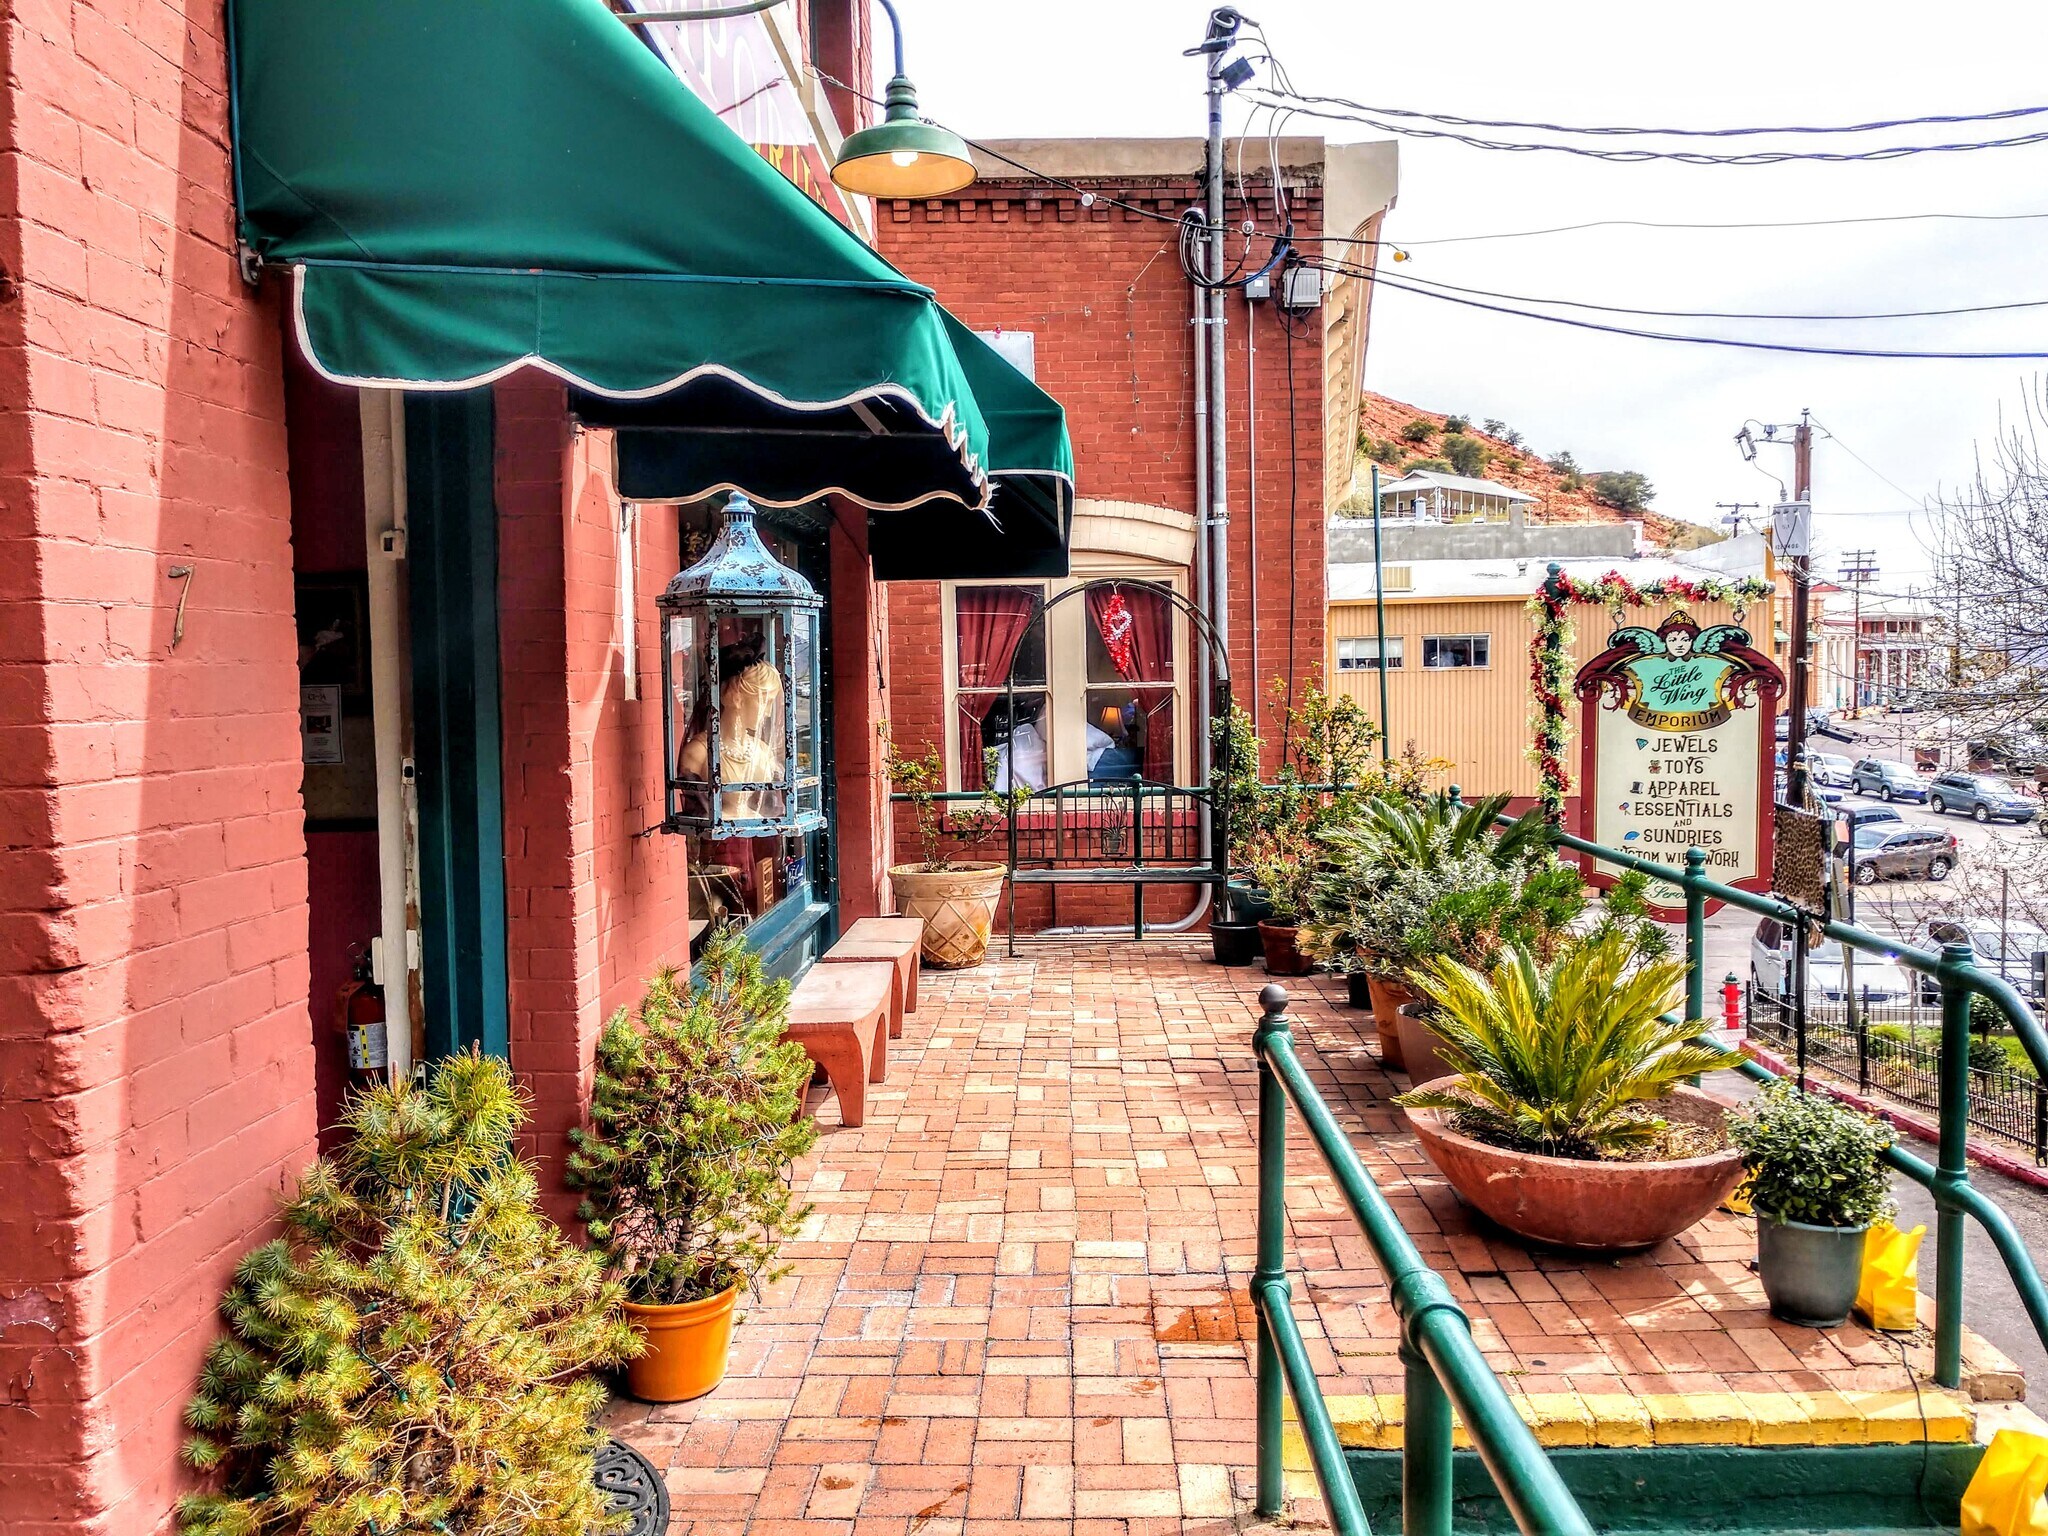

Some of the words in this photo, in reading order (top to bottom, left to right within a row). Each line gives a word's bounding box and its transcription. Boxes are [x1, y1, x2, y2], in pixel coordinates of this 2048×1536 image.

[168, 563, 195, 650] 7
[1650, 665, 1704, 692] Little
[1669, 665, 1686, 676] THE
[1660, 685, 1708, 706] Wing
[1634, 709, 1722, 727] EMPORIUM
[1652, 735, 1718, 752] JEWELS
[1665, 756, 1710, 774] TOYS
[1648, 781, 1720, 798] APPAREL
[1634, 799, 1733, 817] ESSENTIALS
[1674, 818, 1692, 828] AND
[1643, 829, 1722, 847] SUNDRIES
